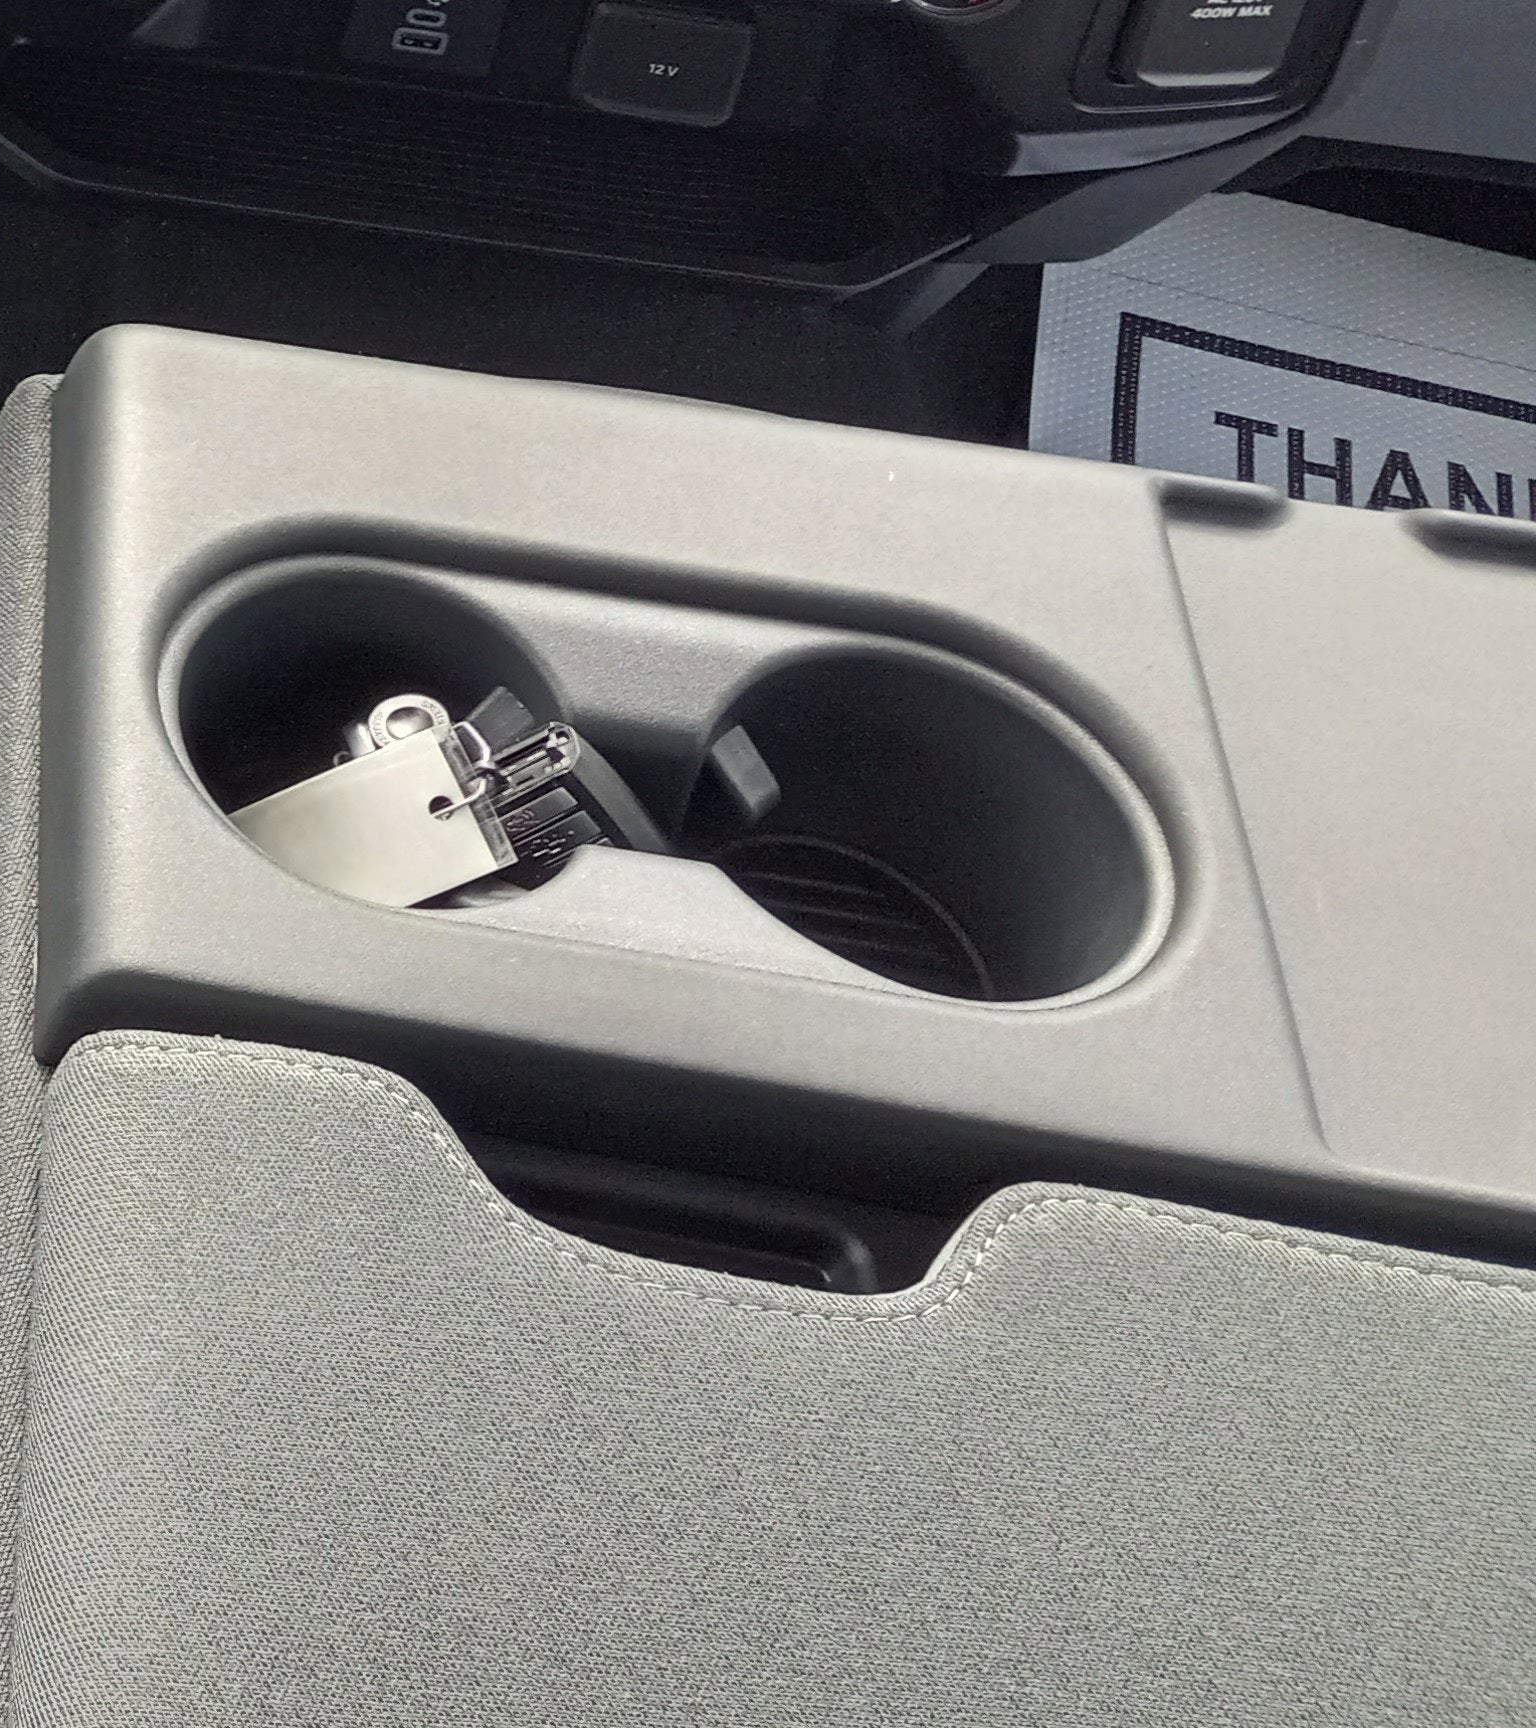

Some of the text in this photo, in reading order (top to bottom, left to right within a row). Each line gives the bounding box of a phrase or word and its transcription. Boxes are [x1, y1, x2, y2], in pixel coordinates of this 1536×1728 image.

[1189, 4, 1274, 20] 400W MAX
[1213, 410, 1536, 519] THAN
